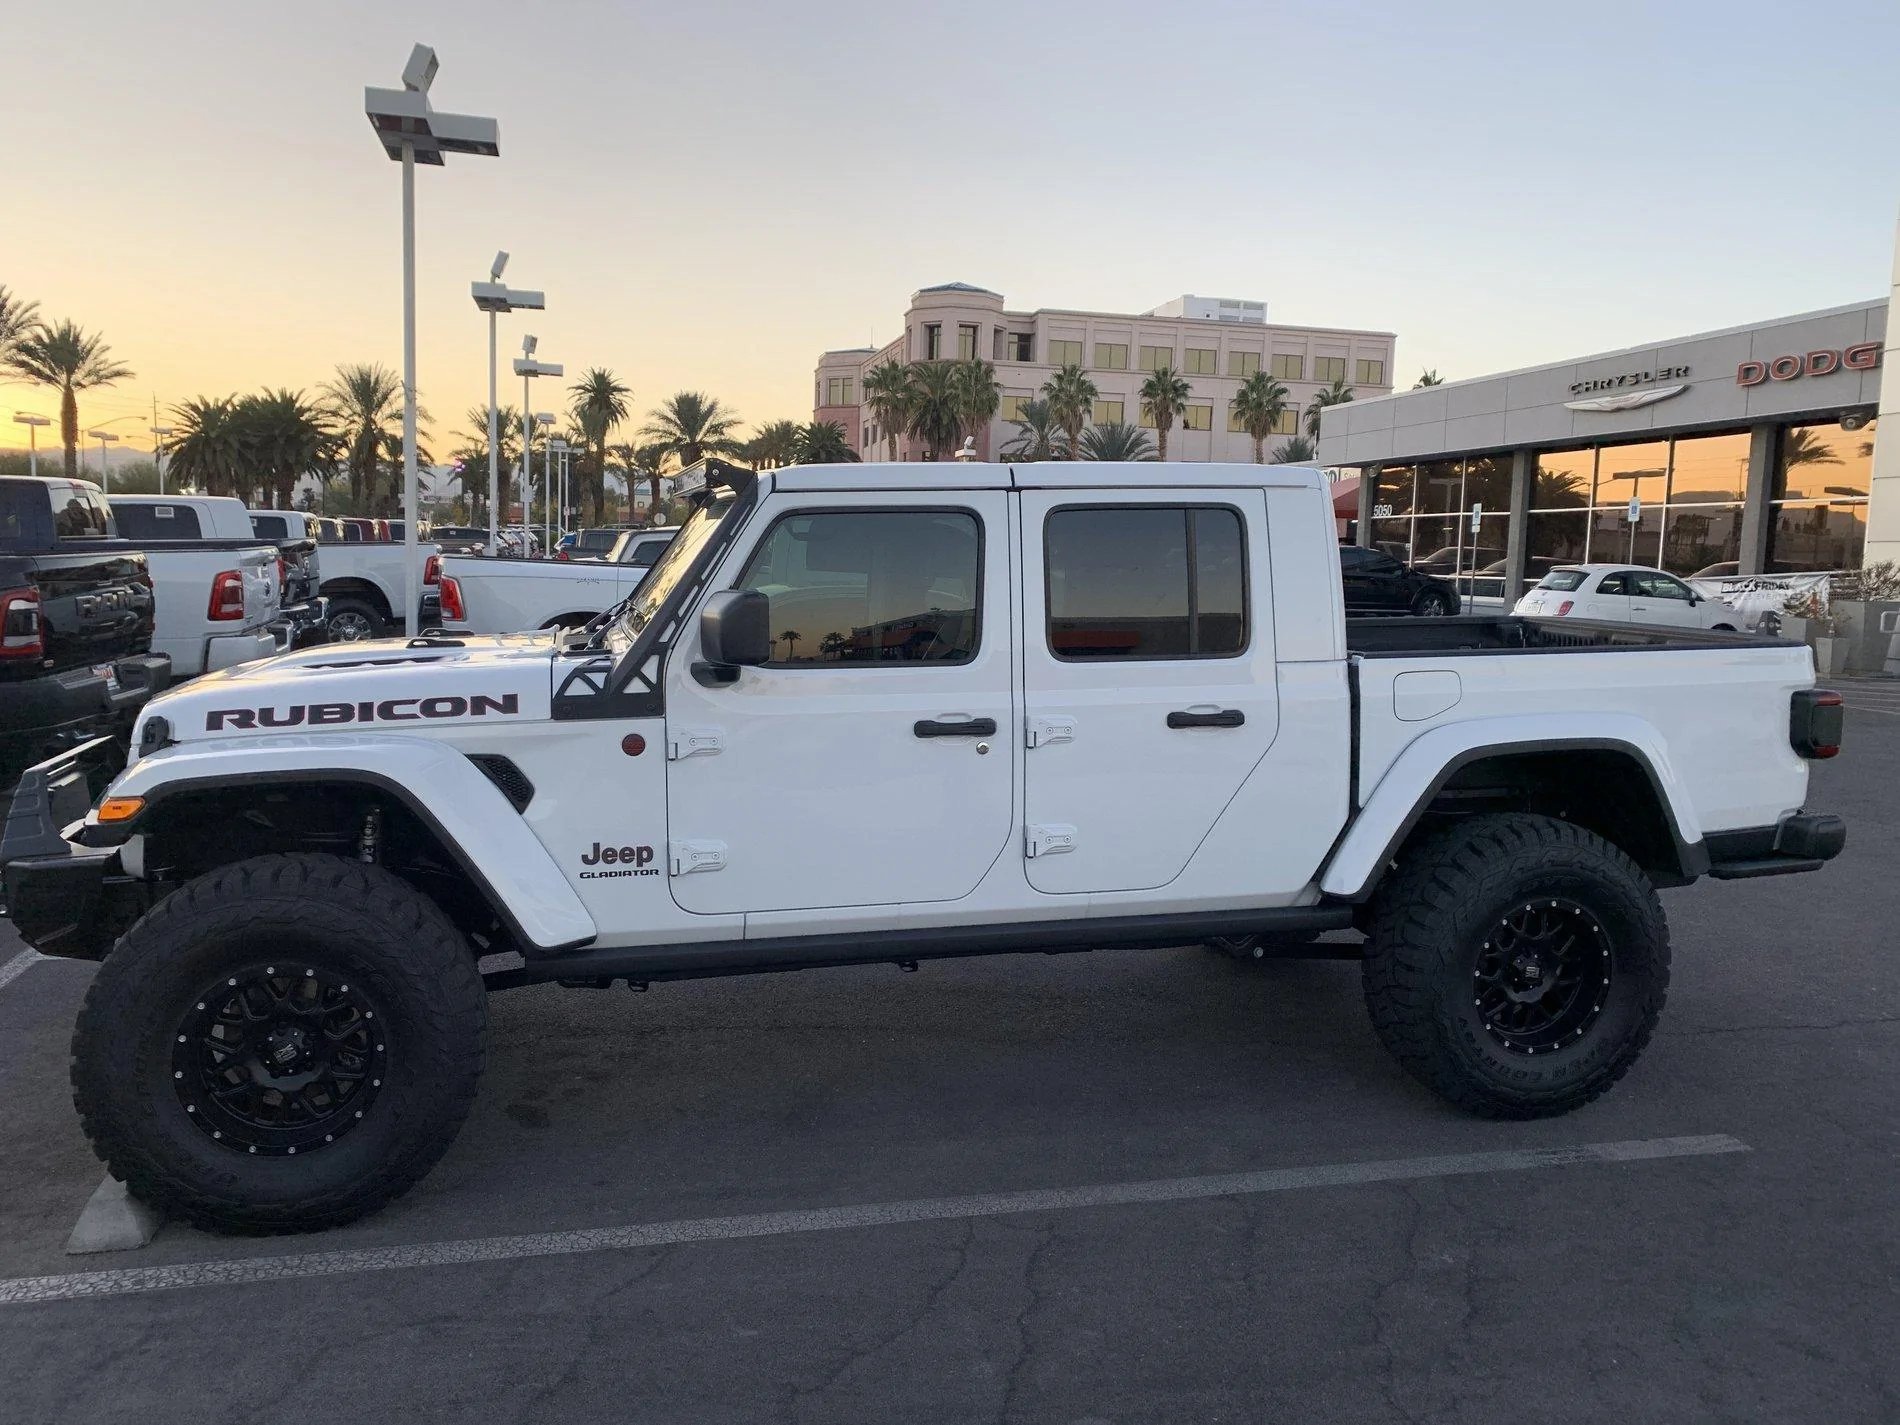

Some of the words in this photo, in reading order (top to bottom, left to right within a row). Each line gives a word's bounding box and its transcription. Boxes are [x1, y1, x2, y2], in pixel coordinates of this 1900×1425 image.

[1568, 366, 1691, 395] CHRYSLER
[1373, 504, 1393, 517] 5050
[1756, 580, 1791, 591] FRIDAY
[206, 694, 518, 731] RUBICON
[581, 842, 654, 867] Jeep
[580, 869, 660, 879] GLADIATOR
